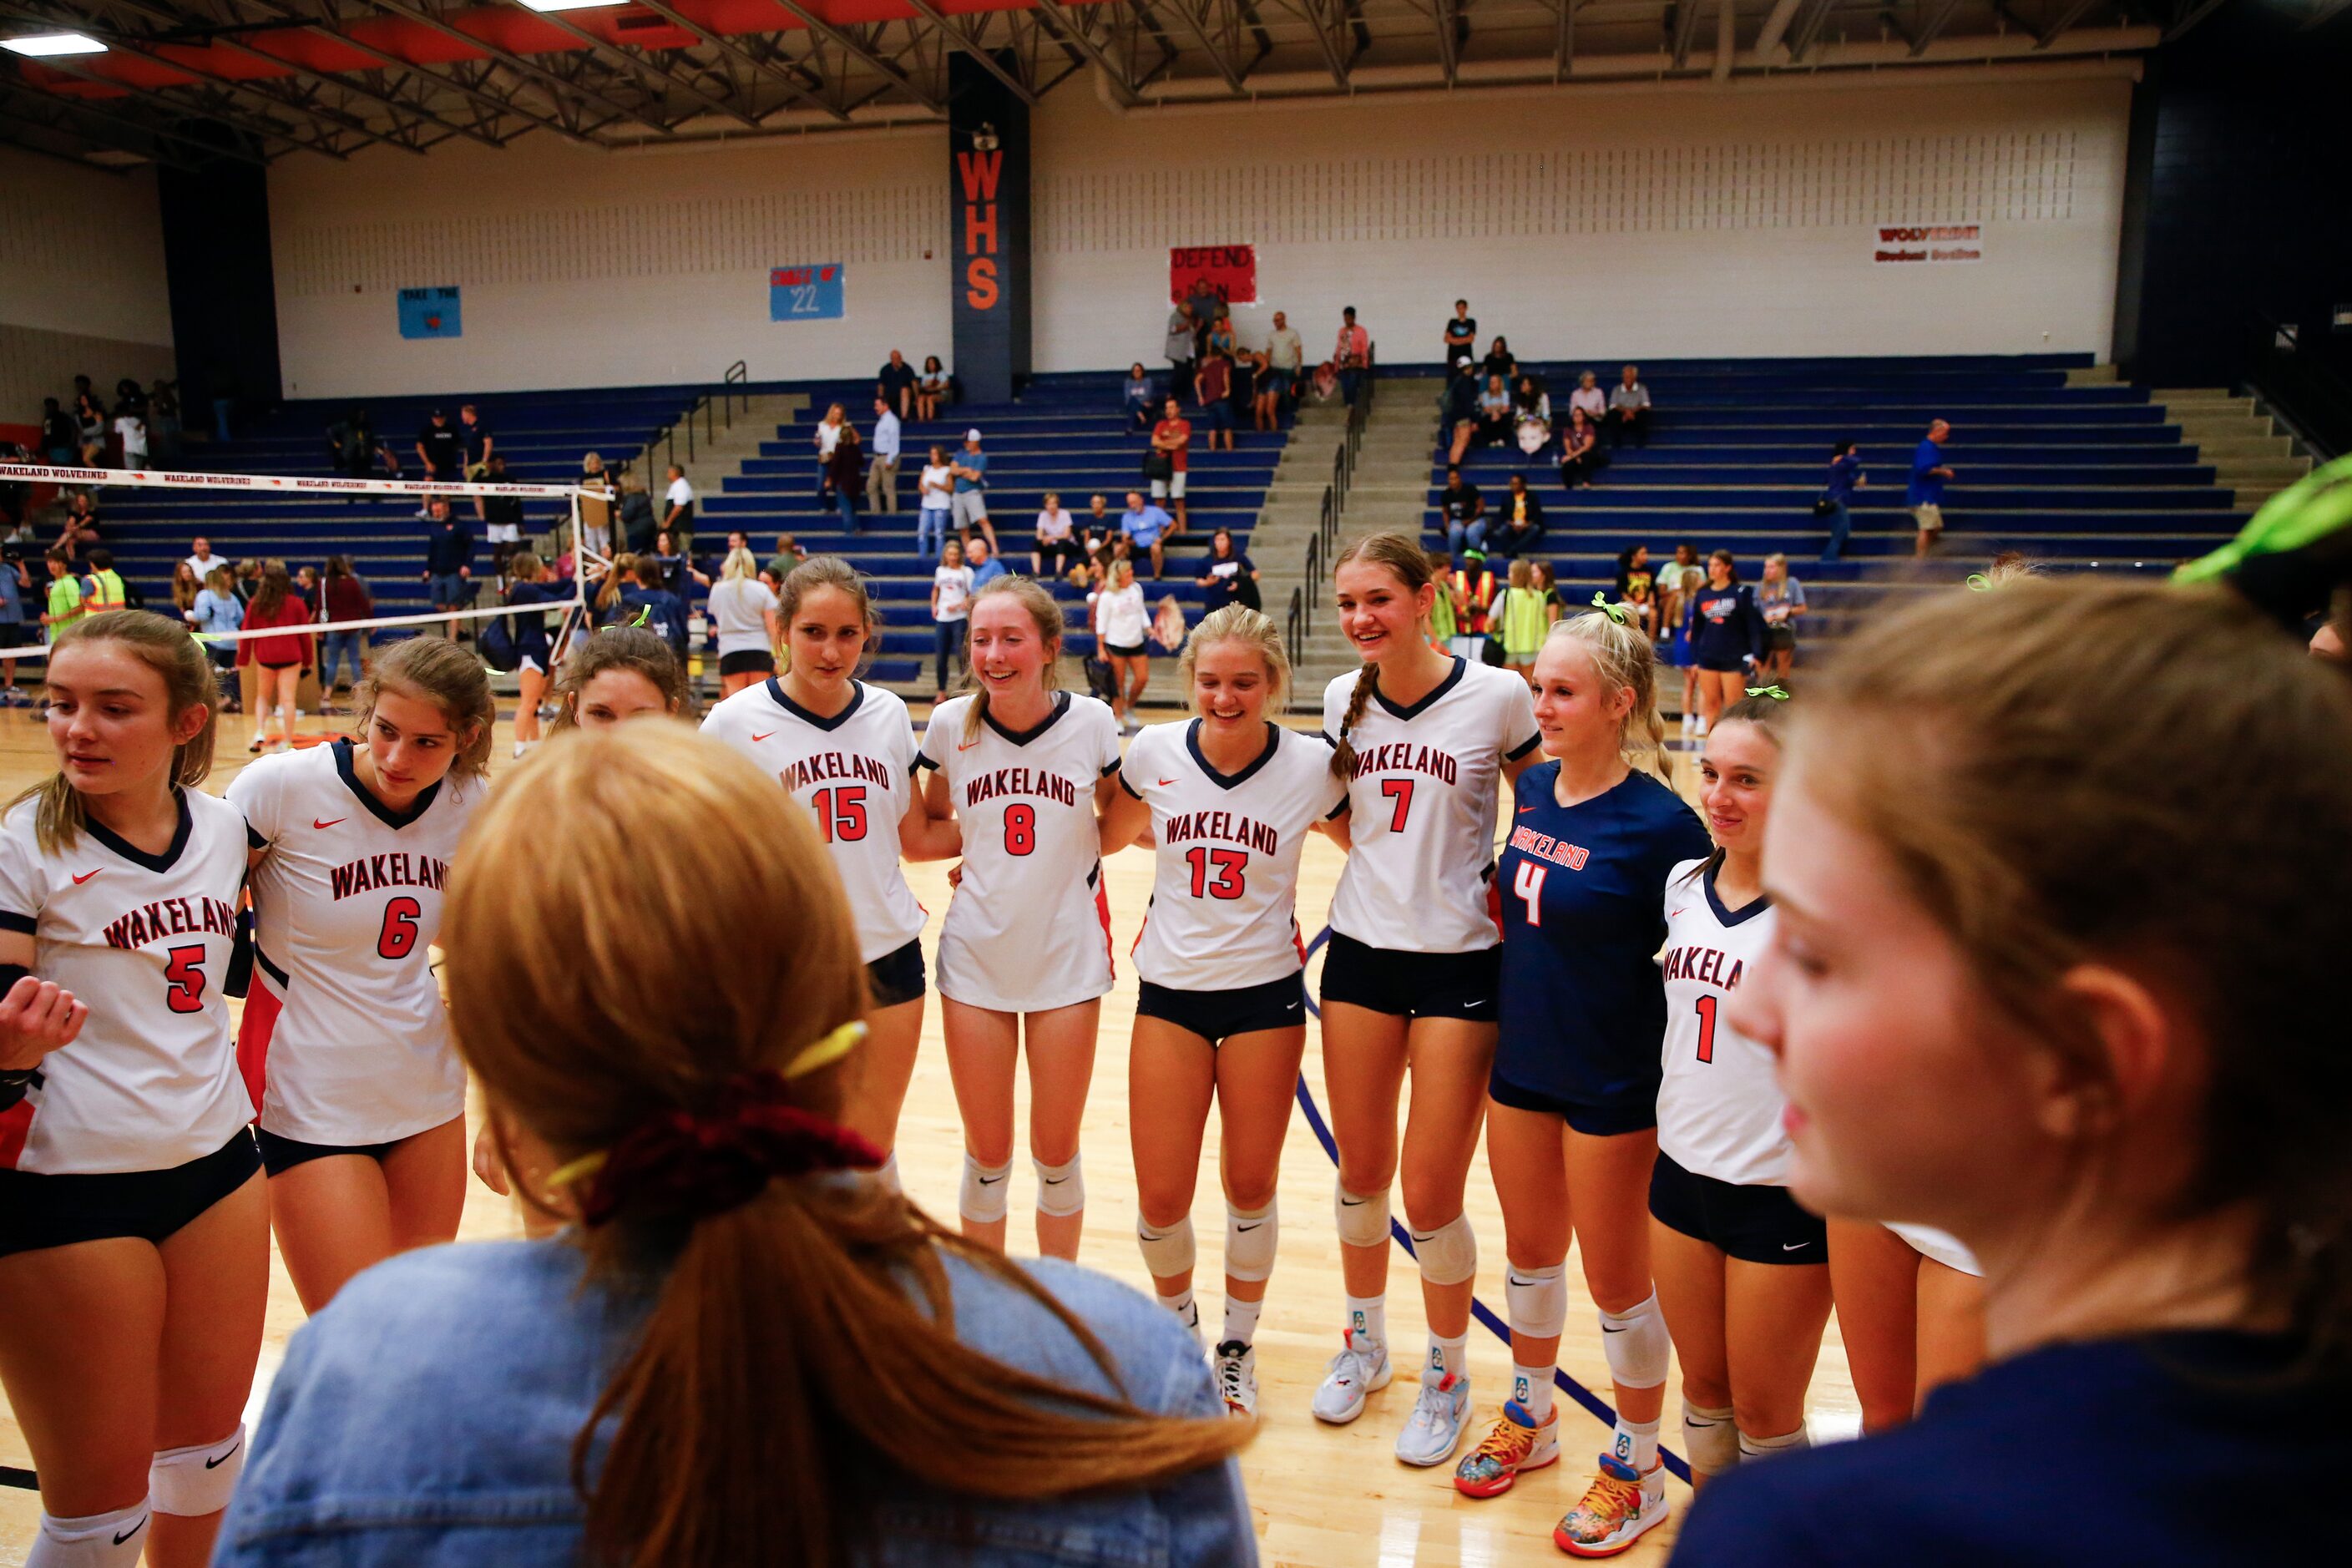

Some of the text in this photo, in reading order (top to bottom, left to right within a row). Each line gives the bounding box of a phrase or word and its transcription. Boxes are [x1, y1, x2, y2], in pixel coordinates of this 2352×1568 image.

[957, 149, 1004, 310] WHS
[1171, 247, 1252, 269] DEFEND
[0, 466, 108, 480] WAKELAND WOLVERINES
[779, 751, 890, 792] WAKELAND
[967, 767, 1075, 808] WAKELAND
[1350, 743, 1457, 787] WAKELAND
[812, 786, 867, 843] 15
[1004, 803, 1035, 856] 8
[1382, 778, 1414, 832] 7
[1166, 811, 1278, 857] WAKELAND
[1510, 825, 1590, 872] WAKELAND
[330, 852, 448, 902] WAKELAN
[1186, 846, 1249, 900] 13
[1514, 858, 1549, 928] 4
[377, 896, 421, 959] 6
[164, 943, 207, 1014] 5
[1695, 994, 1717, 1065] 1
